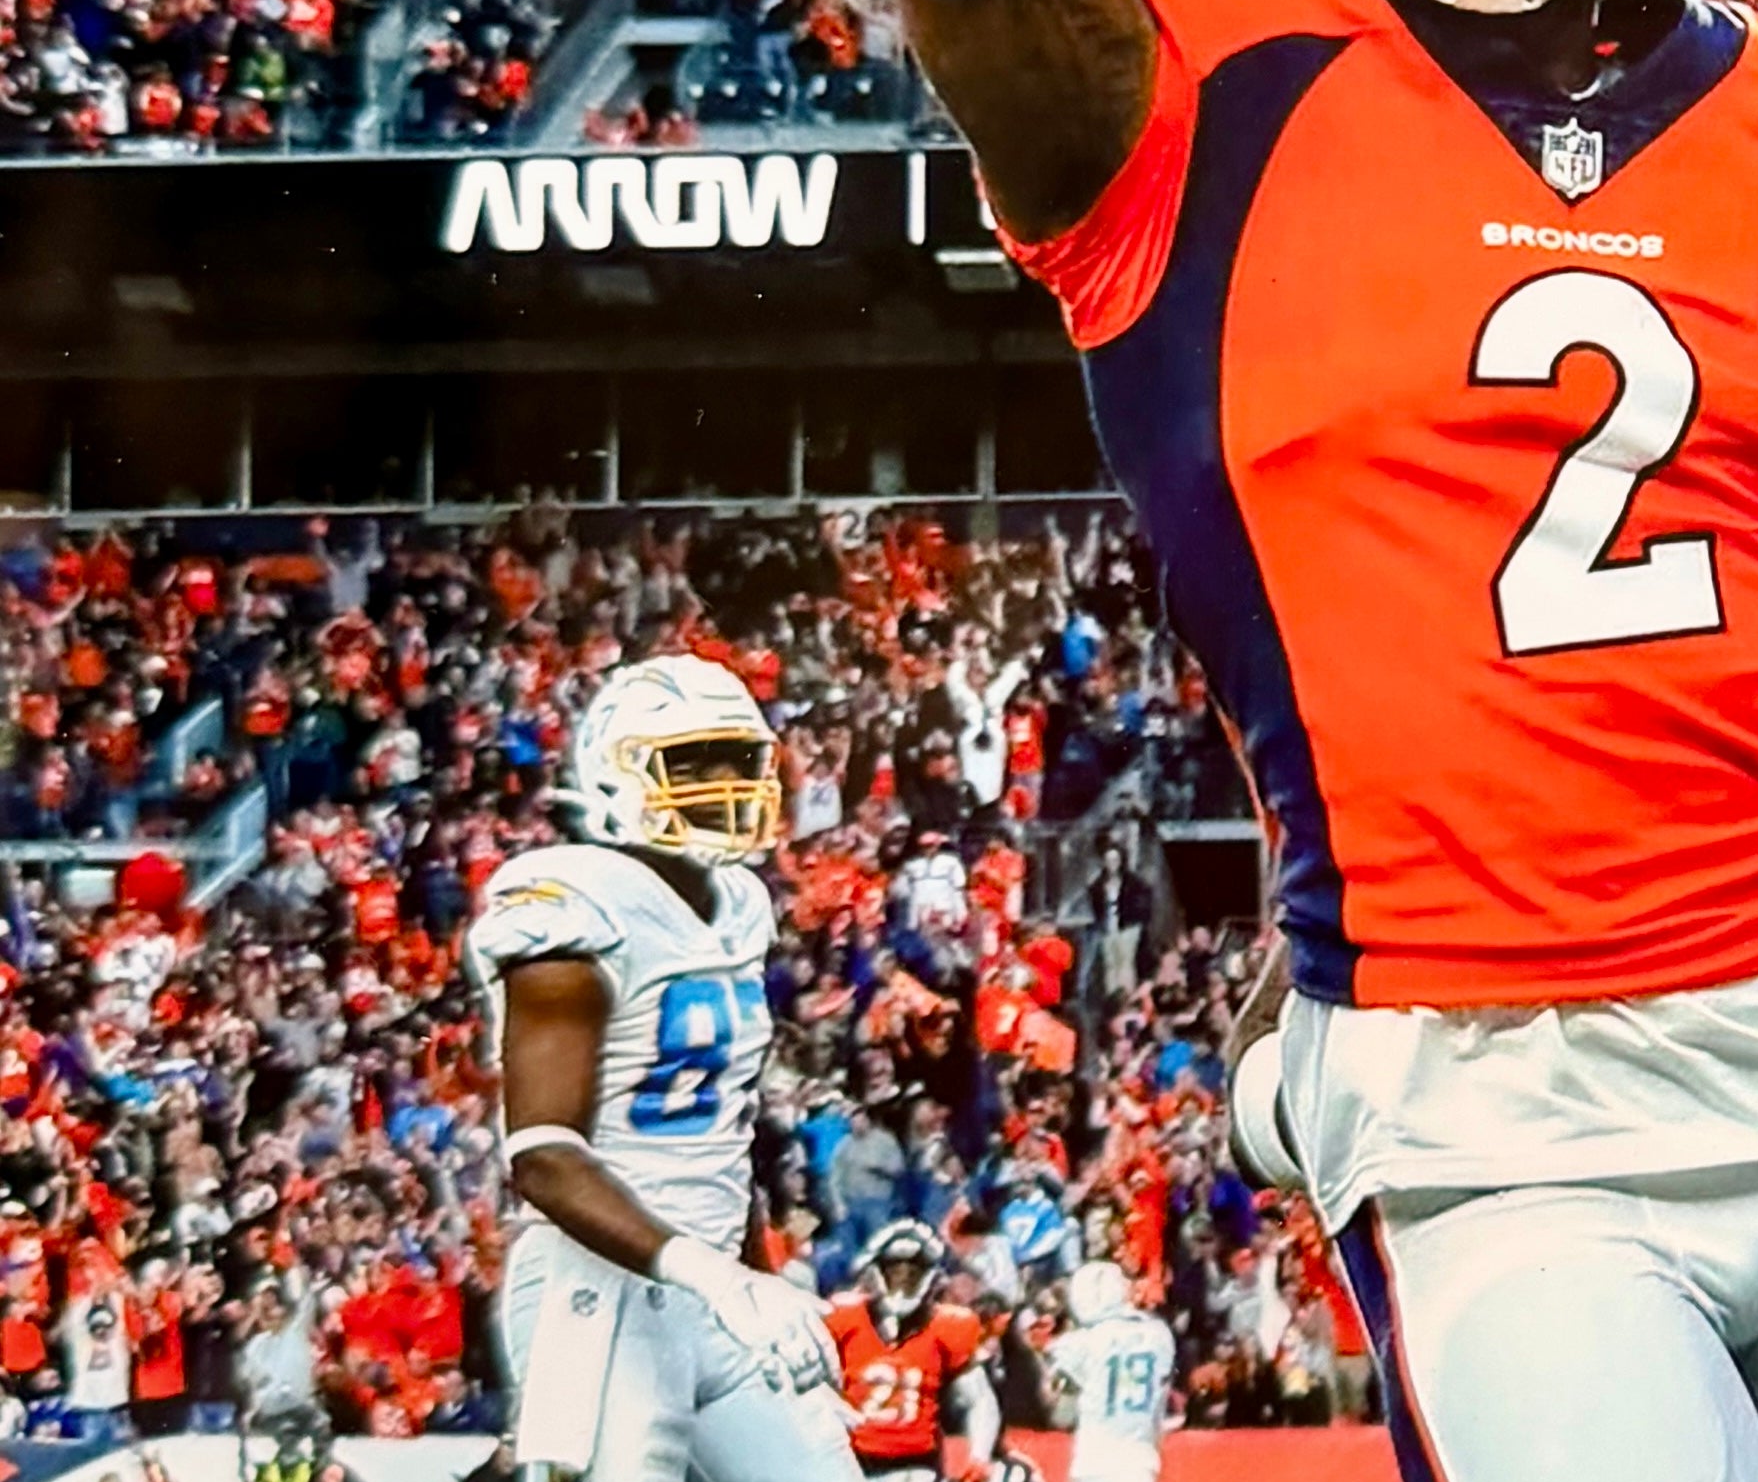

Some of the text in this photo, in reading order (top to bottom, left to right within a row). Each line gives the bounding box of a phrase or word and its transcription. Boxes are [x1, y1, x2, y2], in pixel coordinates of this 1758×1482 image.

[442, 153, 838, 253] ARROW
[1481, 221, 1665, 259] BRONCOS
[1468, 266, 1726, 658] 2
[859, 1362, 924, 1424] 21
